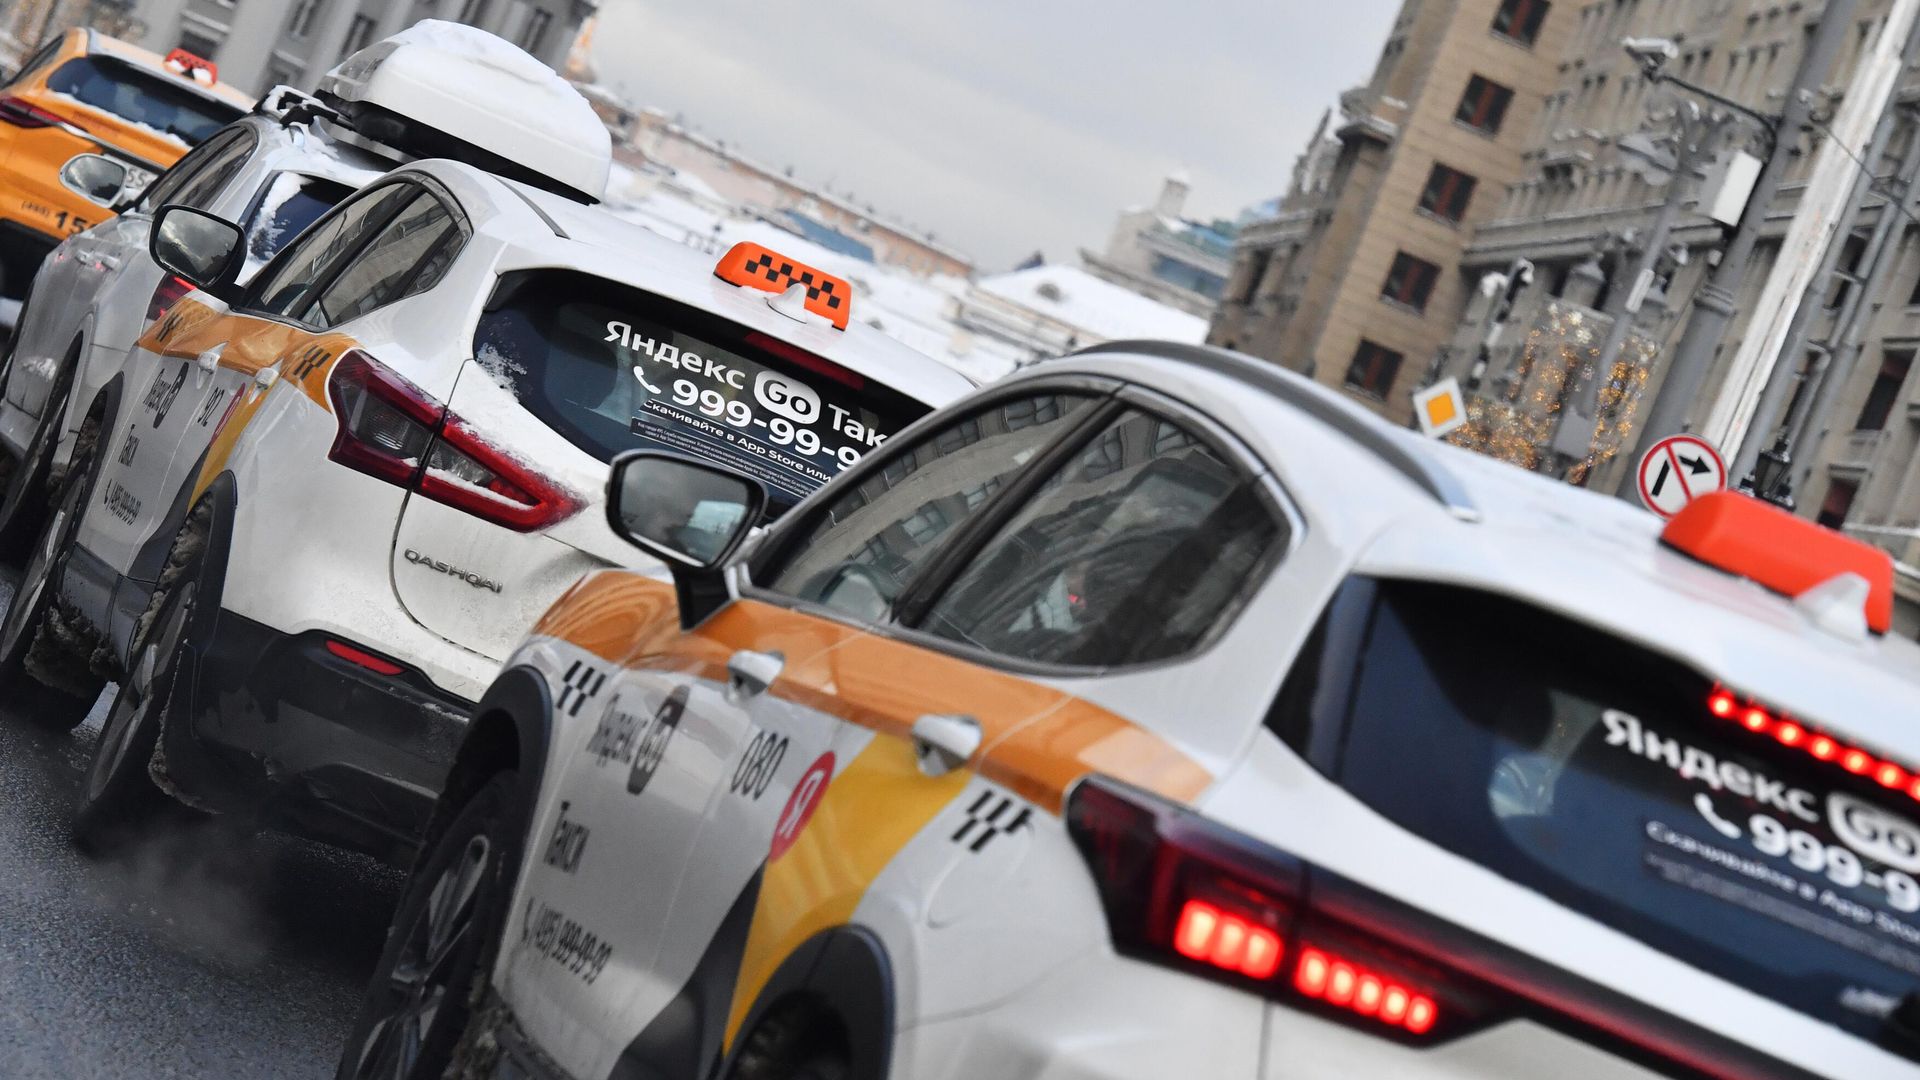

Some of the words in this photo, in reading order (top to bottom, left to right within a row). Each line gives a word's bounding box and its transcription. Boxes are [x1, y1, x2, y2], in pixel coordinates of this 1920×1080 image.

[56, 211, 98, 235] 15
[604, 320, 746, 390] Яндекс
[828, 403, 888, 449] Так
[643, 400, 724, 437] Скачивайте
[726, 433, 735, 442] в
[737, 437, 766, 455] App
[768, 450, 804, 471] Store
[806, 467, 832, 483] или
[672, 379, 863, 472] 999-99-9
[404, 547, 503, 594] QASHQAI
[586, 692, 648, 769] Яндекс
[730, 731, 790, 801] 080
[1602, 708, 1820, 824] Яндекс
[543, 800, 590, 875] Такси
[779, 769, 826, 839] Я
[550, 919, 613, 986] 999-99-99
